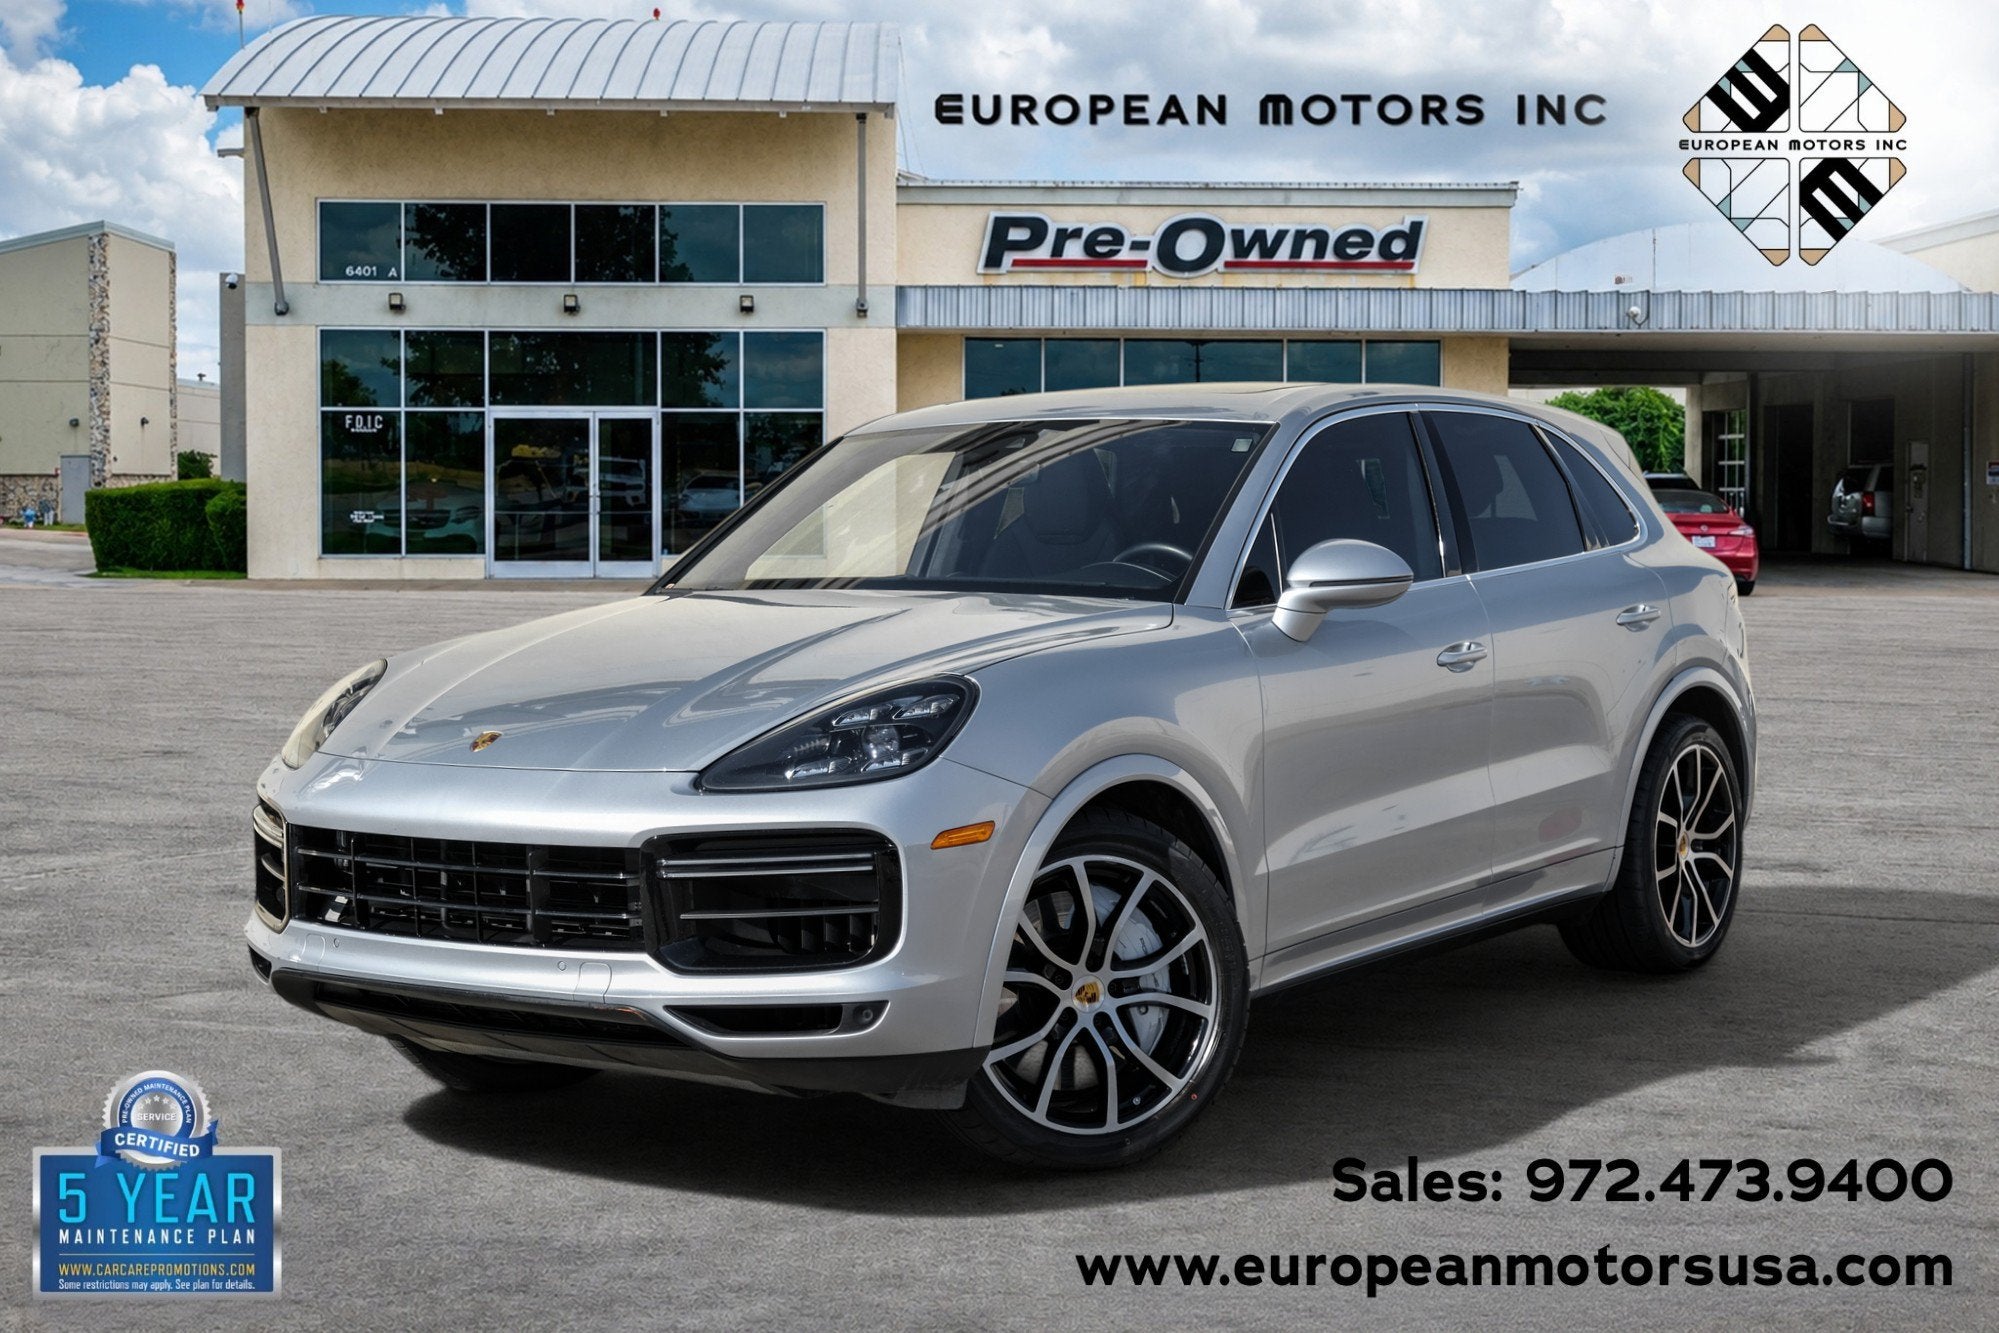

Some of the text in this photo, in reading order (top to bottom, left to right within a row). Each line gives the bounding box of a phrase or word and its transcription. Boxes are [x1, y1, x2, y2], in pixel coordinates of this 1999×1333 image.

[984, 215, 1424, 273] Pre-Owned
[345, 265, 398, 278] 6401 A
